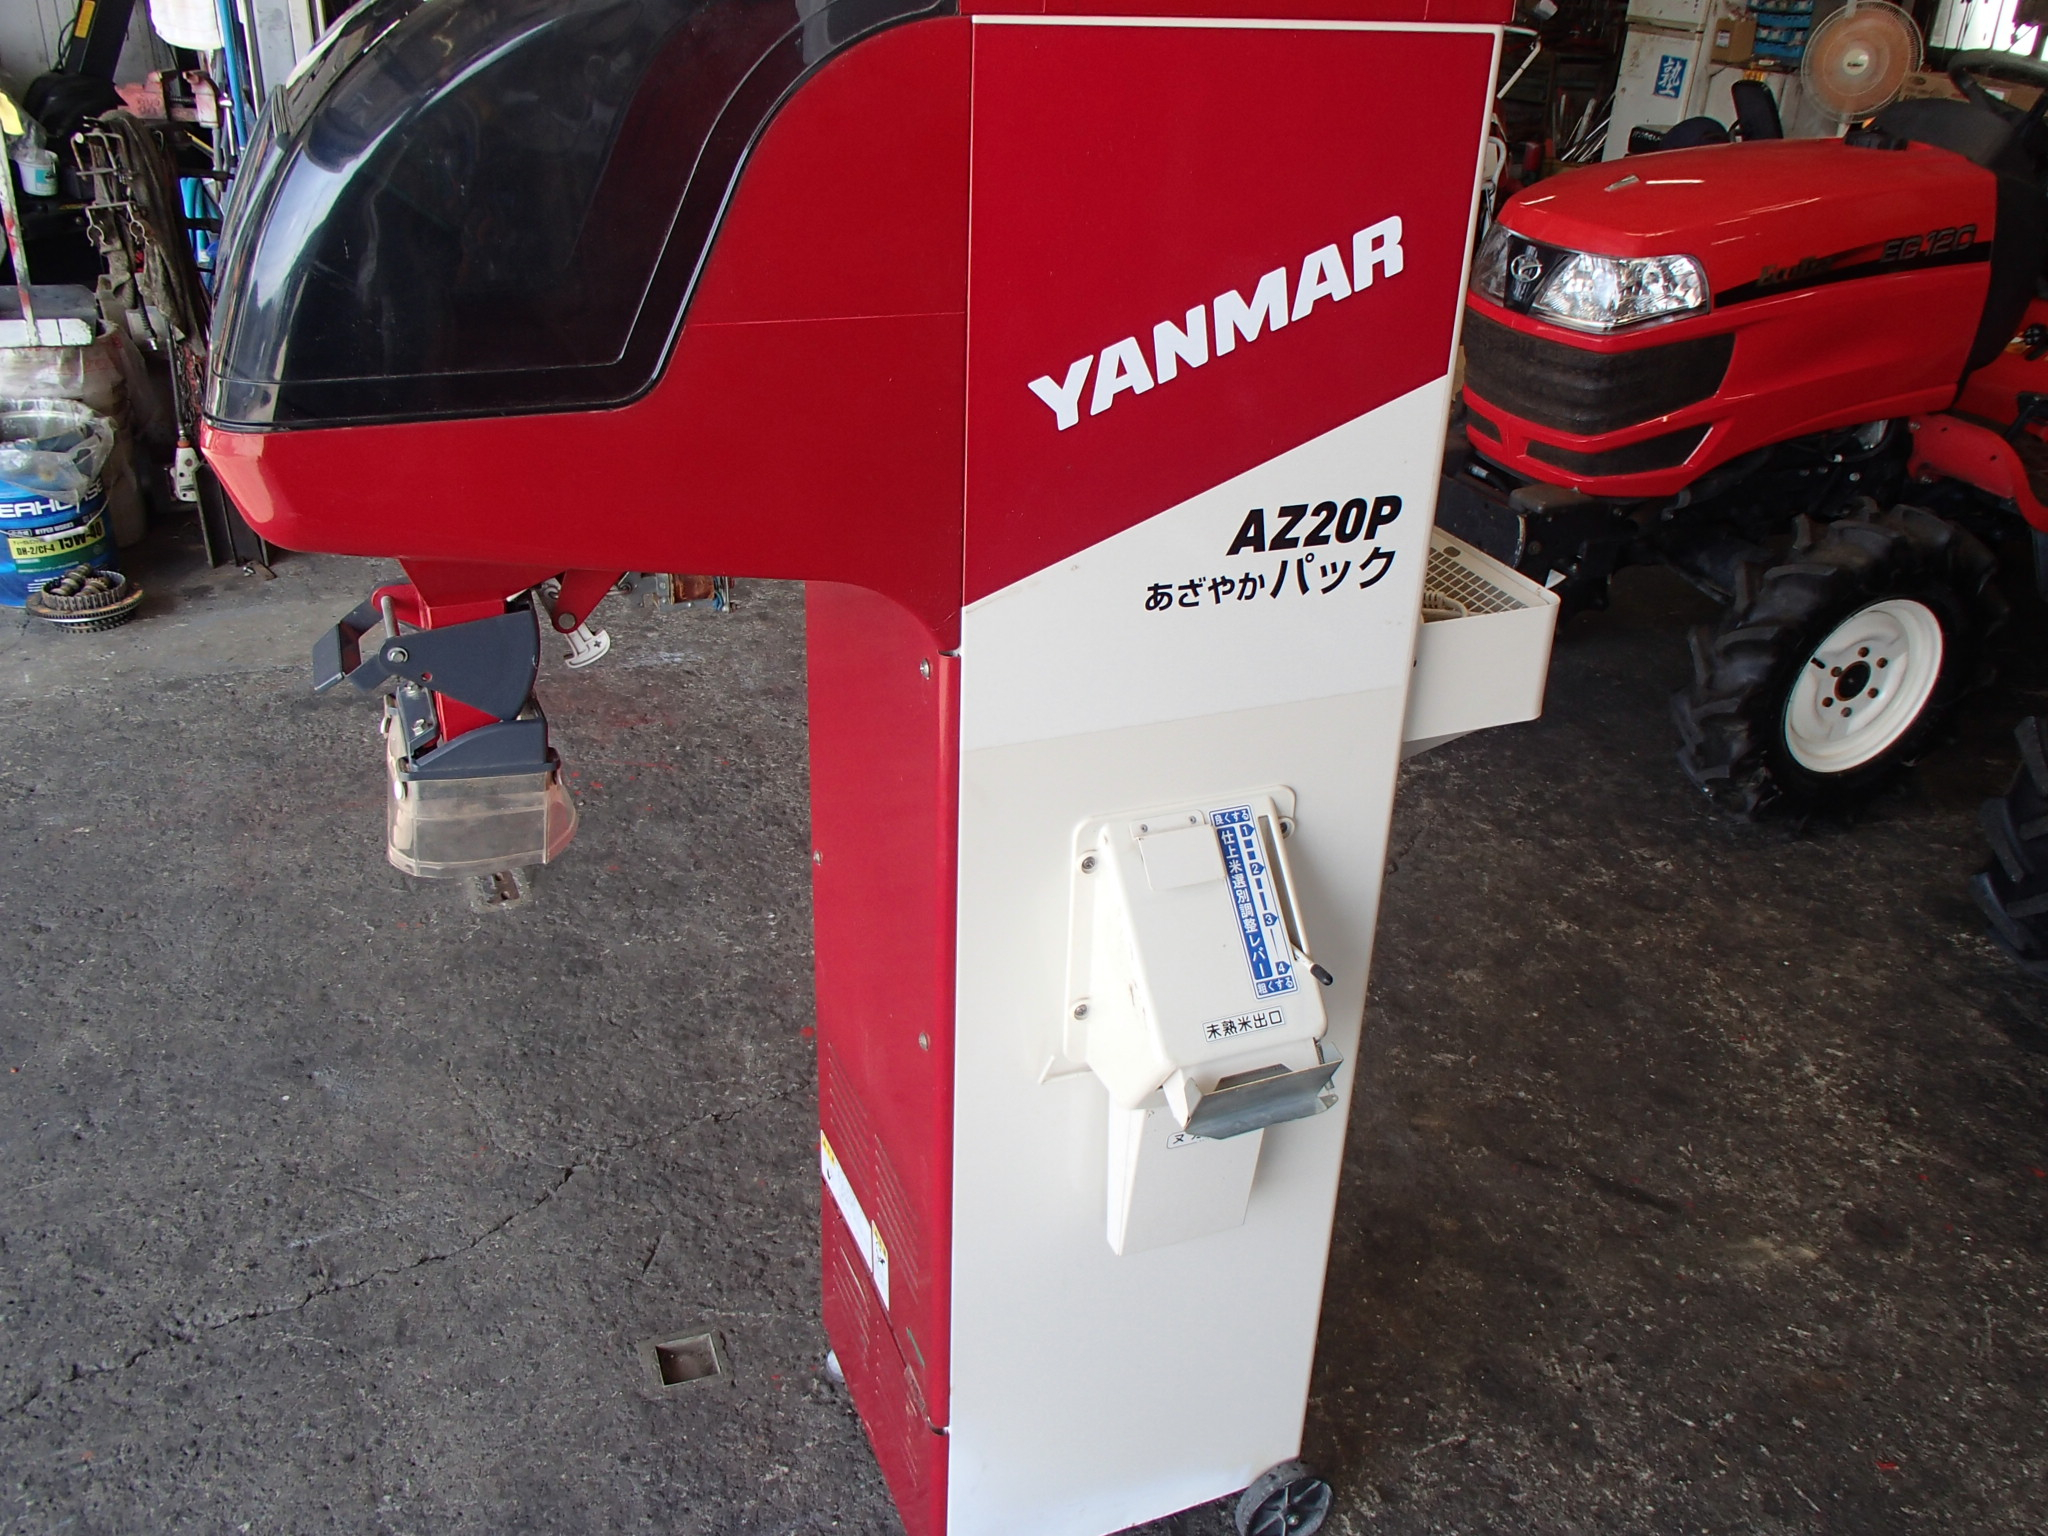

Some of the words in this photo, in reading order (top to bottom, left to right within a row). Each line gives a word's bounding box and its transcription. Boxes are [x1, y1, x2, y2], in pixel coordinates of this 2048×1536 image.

[1027, 215, 1404, 432] YANMAR
[1225, 495, 1403, 556] AZ20P
[1144, 546, 1397, 612] あざやかパック
[1214, 809, 1250, 825] 良くする
[1243, 826, 1249, 836] 1
[1252, 864, 1260, 875] 2
[1221, 830, 1267, 977] 仕上米選別調整レバー
[1265, 915, 1273, 925] 3
[1278, 962, 1286, 973] 4
[1256, 976, 1295, 994] 粗くする
[1206, 1010, 1283, 1039] 未熟米出口
